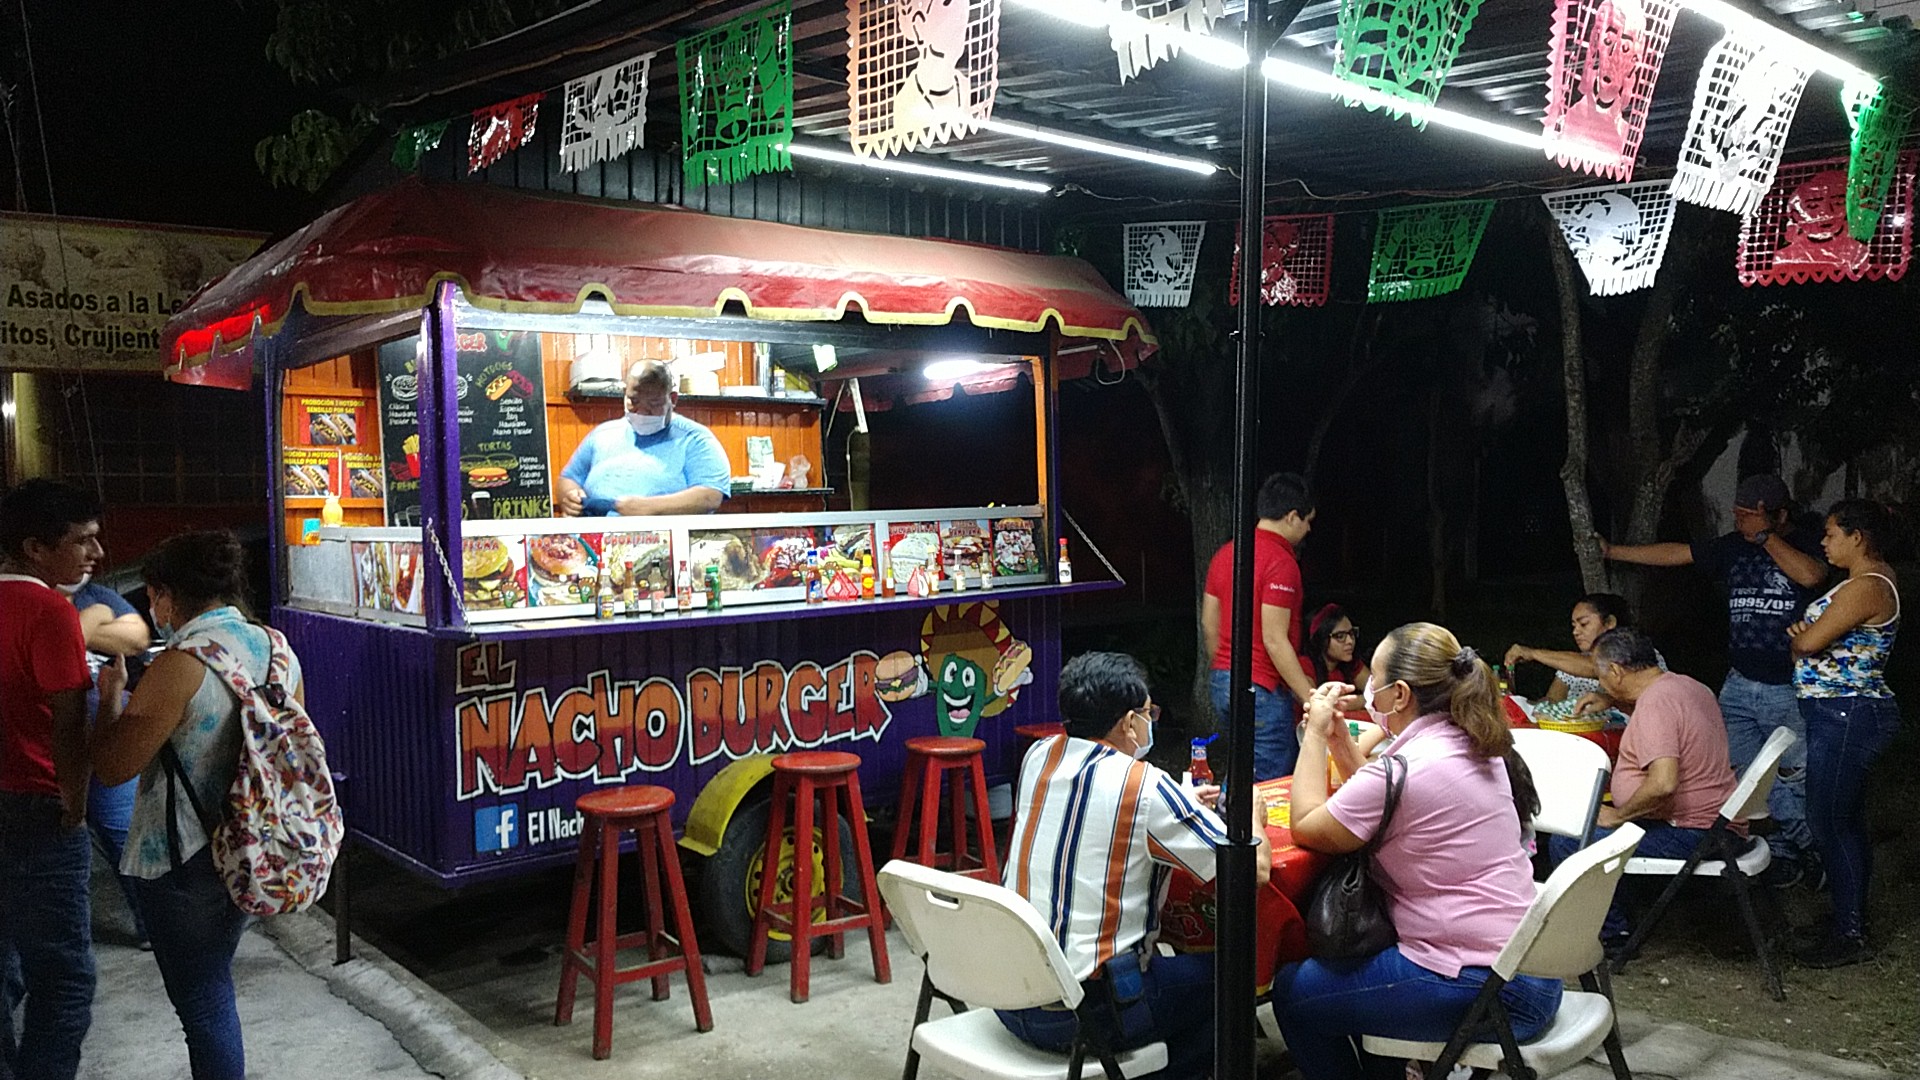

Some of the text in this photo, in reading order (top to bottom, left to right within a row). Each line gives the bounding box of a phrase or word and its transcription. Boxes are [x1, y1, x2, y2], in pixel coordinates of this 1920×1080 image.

[7, 284, 189, 316] Asados a la Le
[0, 321, 56, 350] itos,
[478, 441, 512, 452] TORTAS
[493, 499, 550, 520] DRINKS
[456, 640, 517, 694] EL
[456, 650, 893, 800] NACHO BURGER
[528, 811, 544, 846] El
